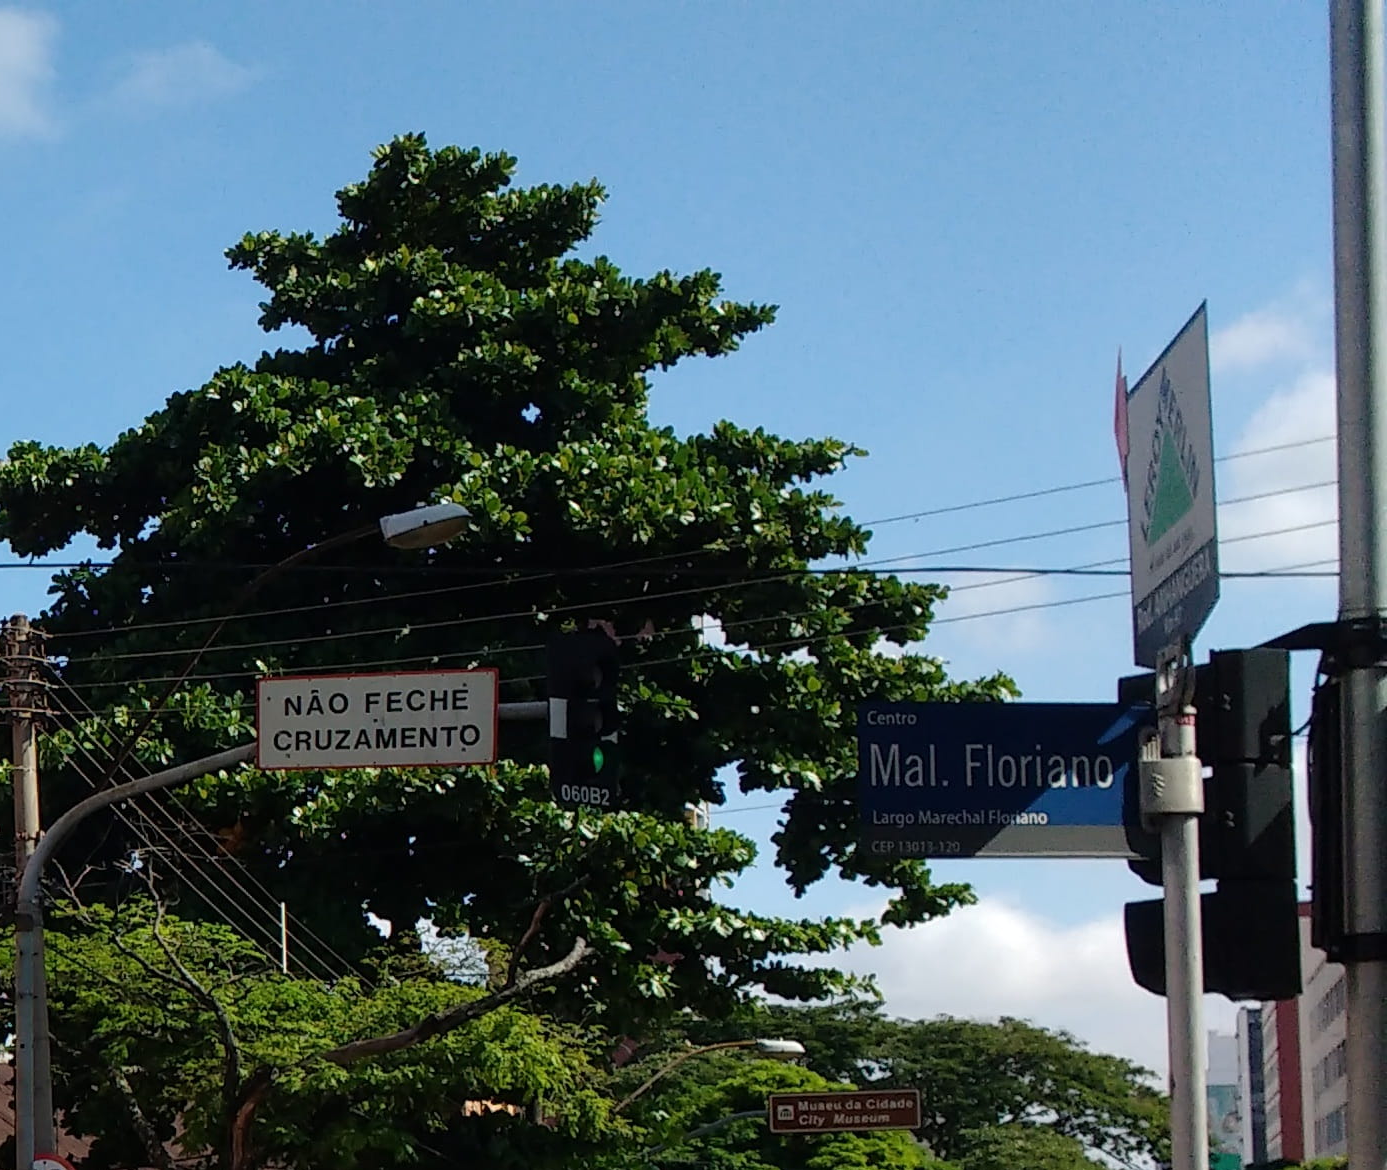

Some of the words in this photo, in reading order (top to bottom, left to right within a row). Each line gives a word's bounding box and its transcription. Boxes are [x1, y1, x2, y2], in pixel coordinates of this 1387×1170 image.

[283, 689, 349, 716] NÃO
[365, 688, 469, 714] FECHE
[867, 710, 917, 726] Centro
[273, 724, 481, 752] CRUZAMENTO
[870, 743, 949, 788] Mal.
[965, 743, 1114, 789] Floriano
[561, 784, 610, 806] 060B2
[873, 810, 915, 828] Largo
[919, 810, 984, 825] Marechal
[989, 810, 1049, 825] Floriano
[871, 841, 895, 853] CEP
[798, 1100, 842, 1112] Museu
[845, 1099, 862, 1110] da
[865, 1098, 914, 1110] Cidade
[798, 1114, 825, 1127] City
[833, 1113, 891, 1125] Museum
